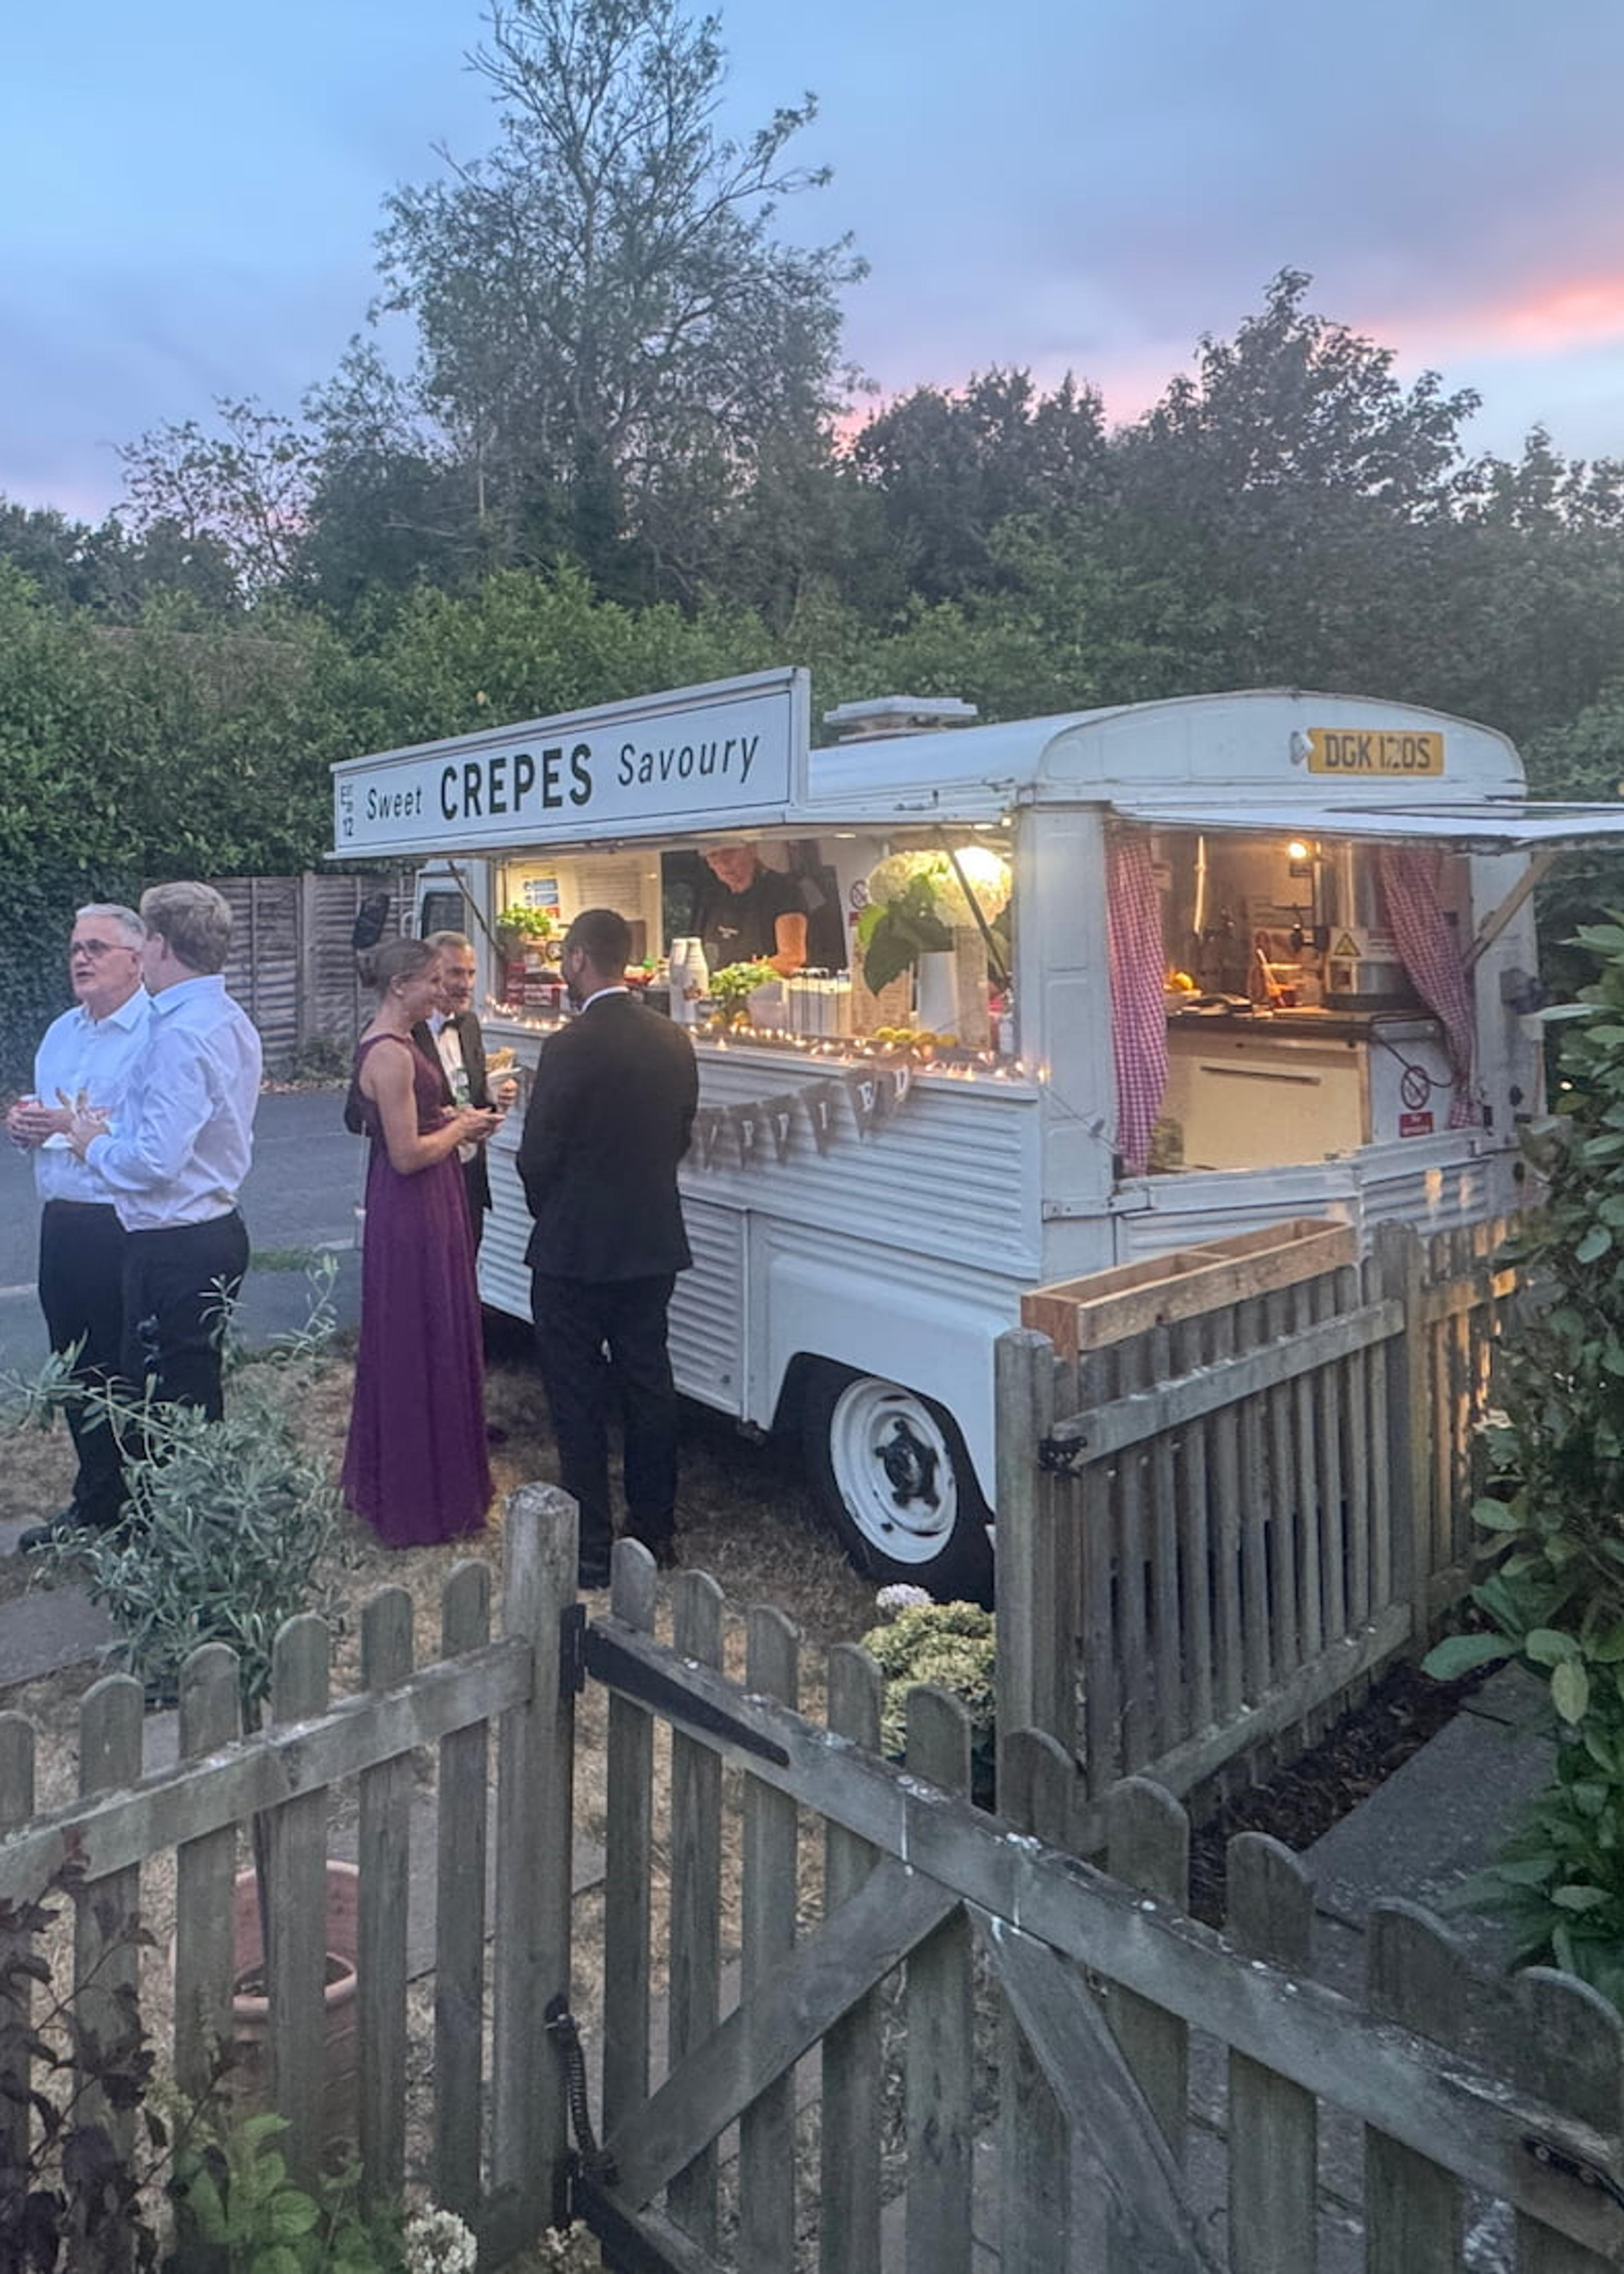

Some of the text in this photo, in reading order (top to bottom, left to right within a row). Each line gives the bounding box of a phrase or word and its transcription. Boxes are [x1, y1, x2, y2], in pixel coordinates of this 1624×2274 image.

[367, 786, 421, 820] Sweet
[441, 743, 592, 820] CREPES
[618, 735, 760, 786] Savoury
[1324, 734, 1372, 768] DGK
